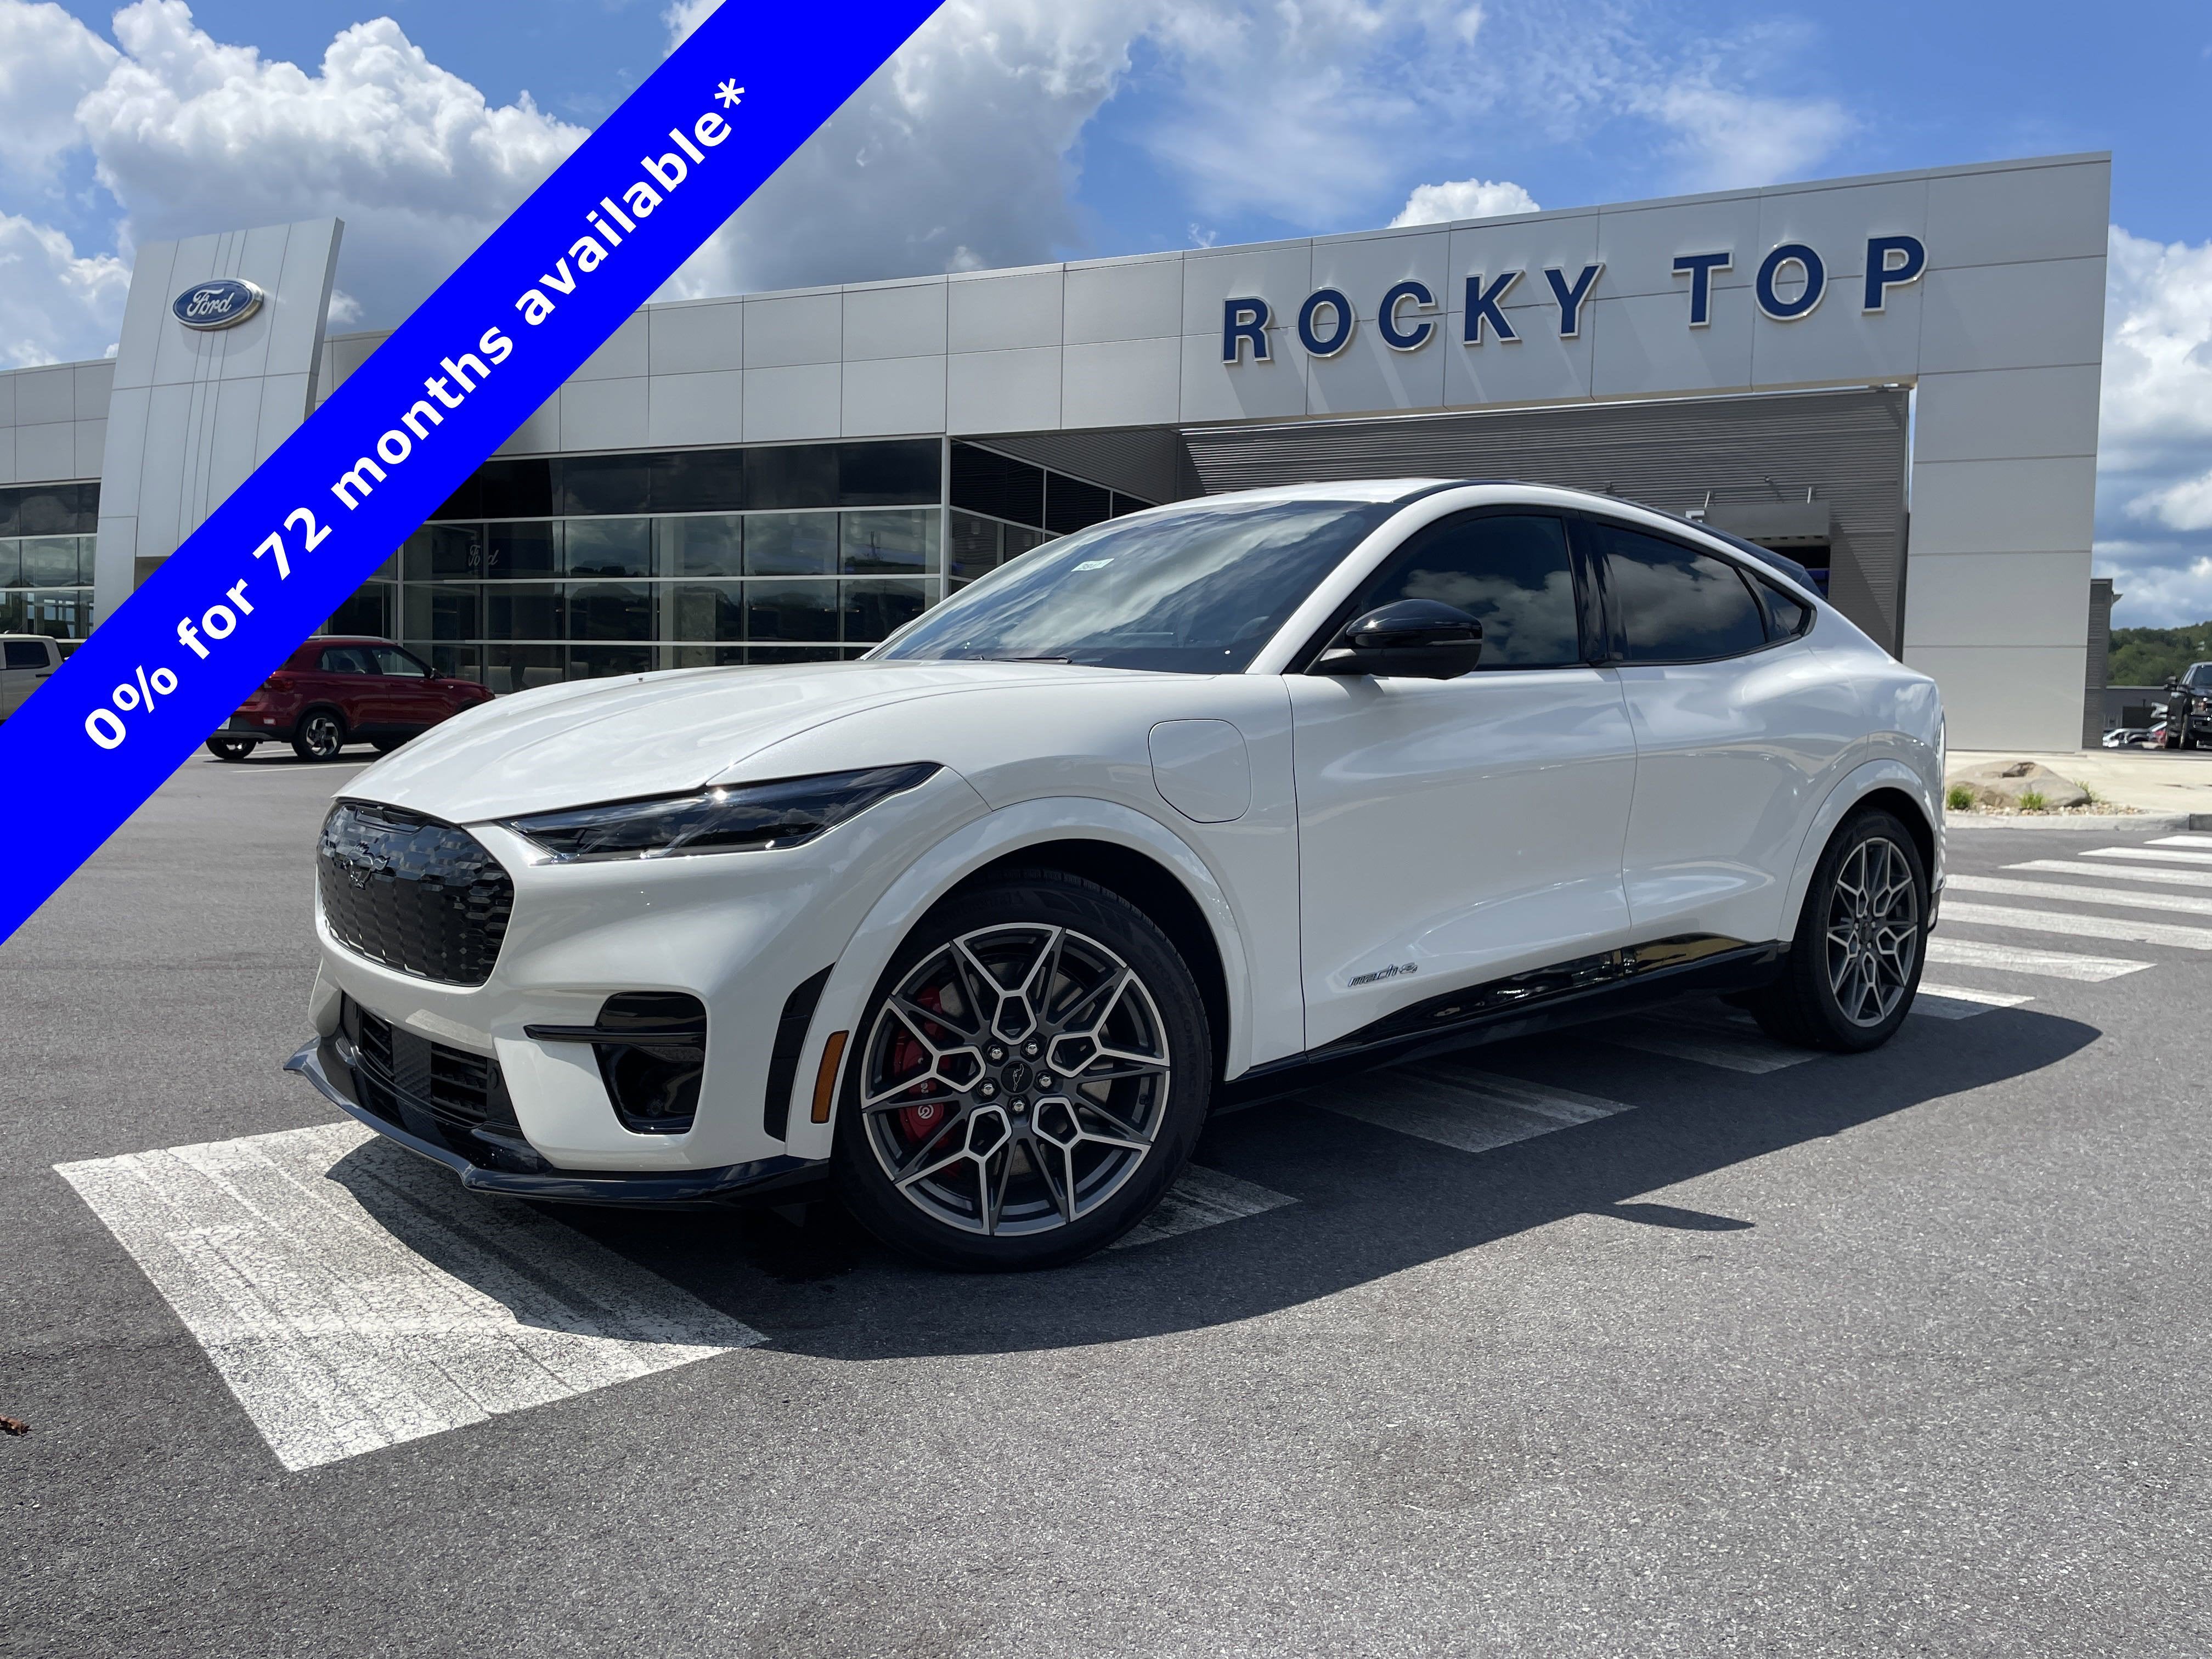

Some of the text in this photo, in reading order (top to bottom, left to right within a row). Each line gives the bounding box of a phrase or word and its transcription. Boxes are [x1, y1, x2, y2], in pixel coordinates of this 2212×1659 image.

[187, 288, 235, 317] Ford
[1222, 235, 1928, 364] ROCKY TOP
[469, 544, 499, 566] Fod
